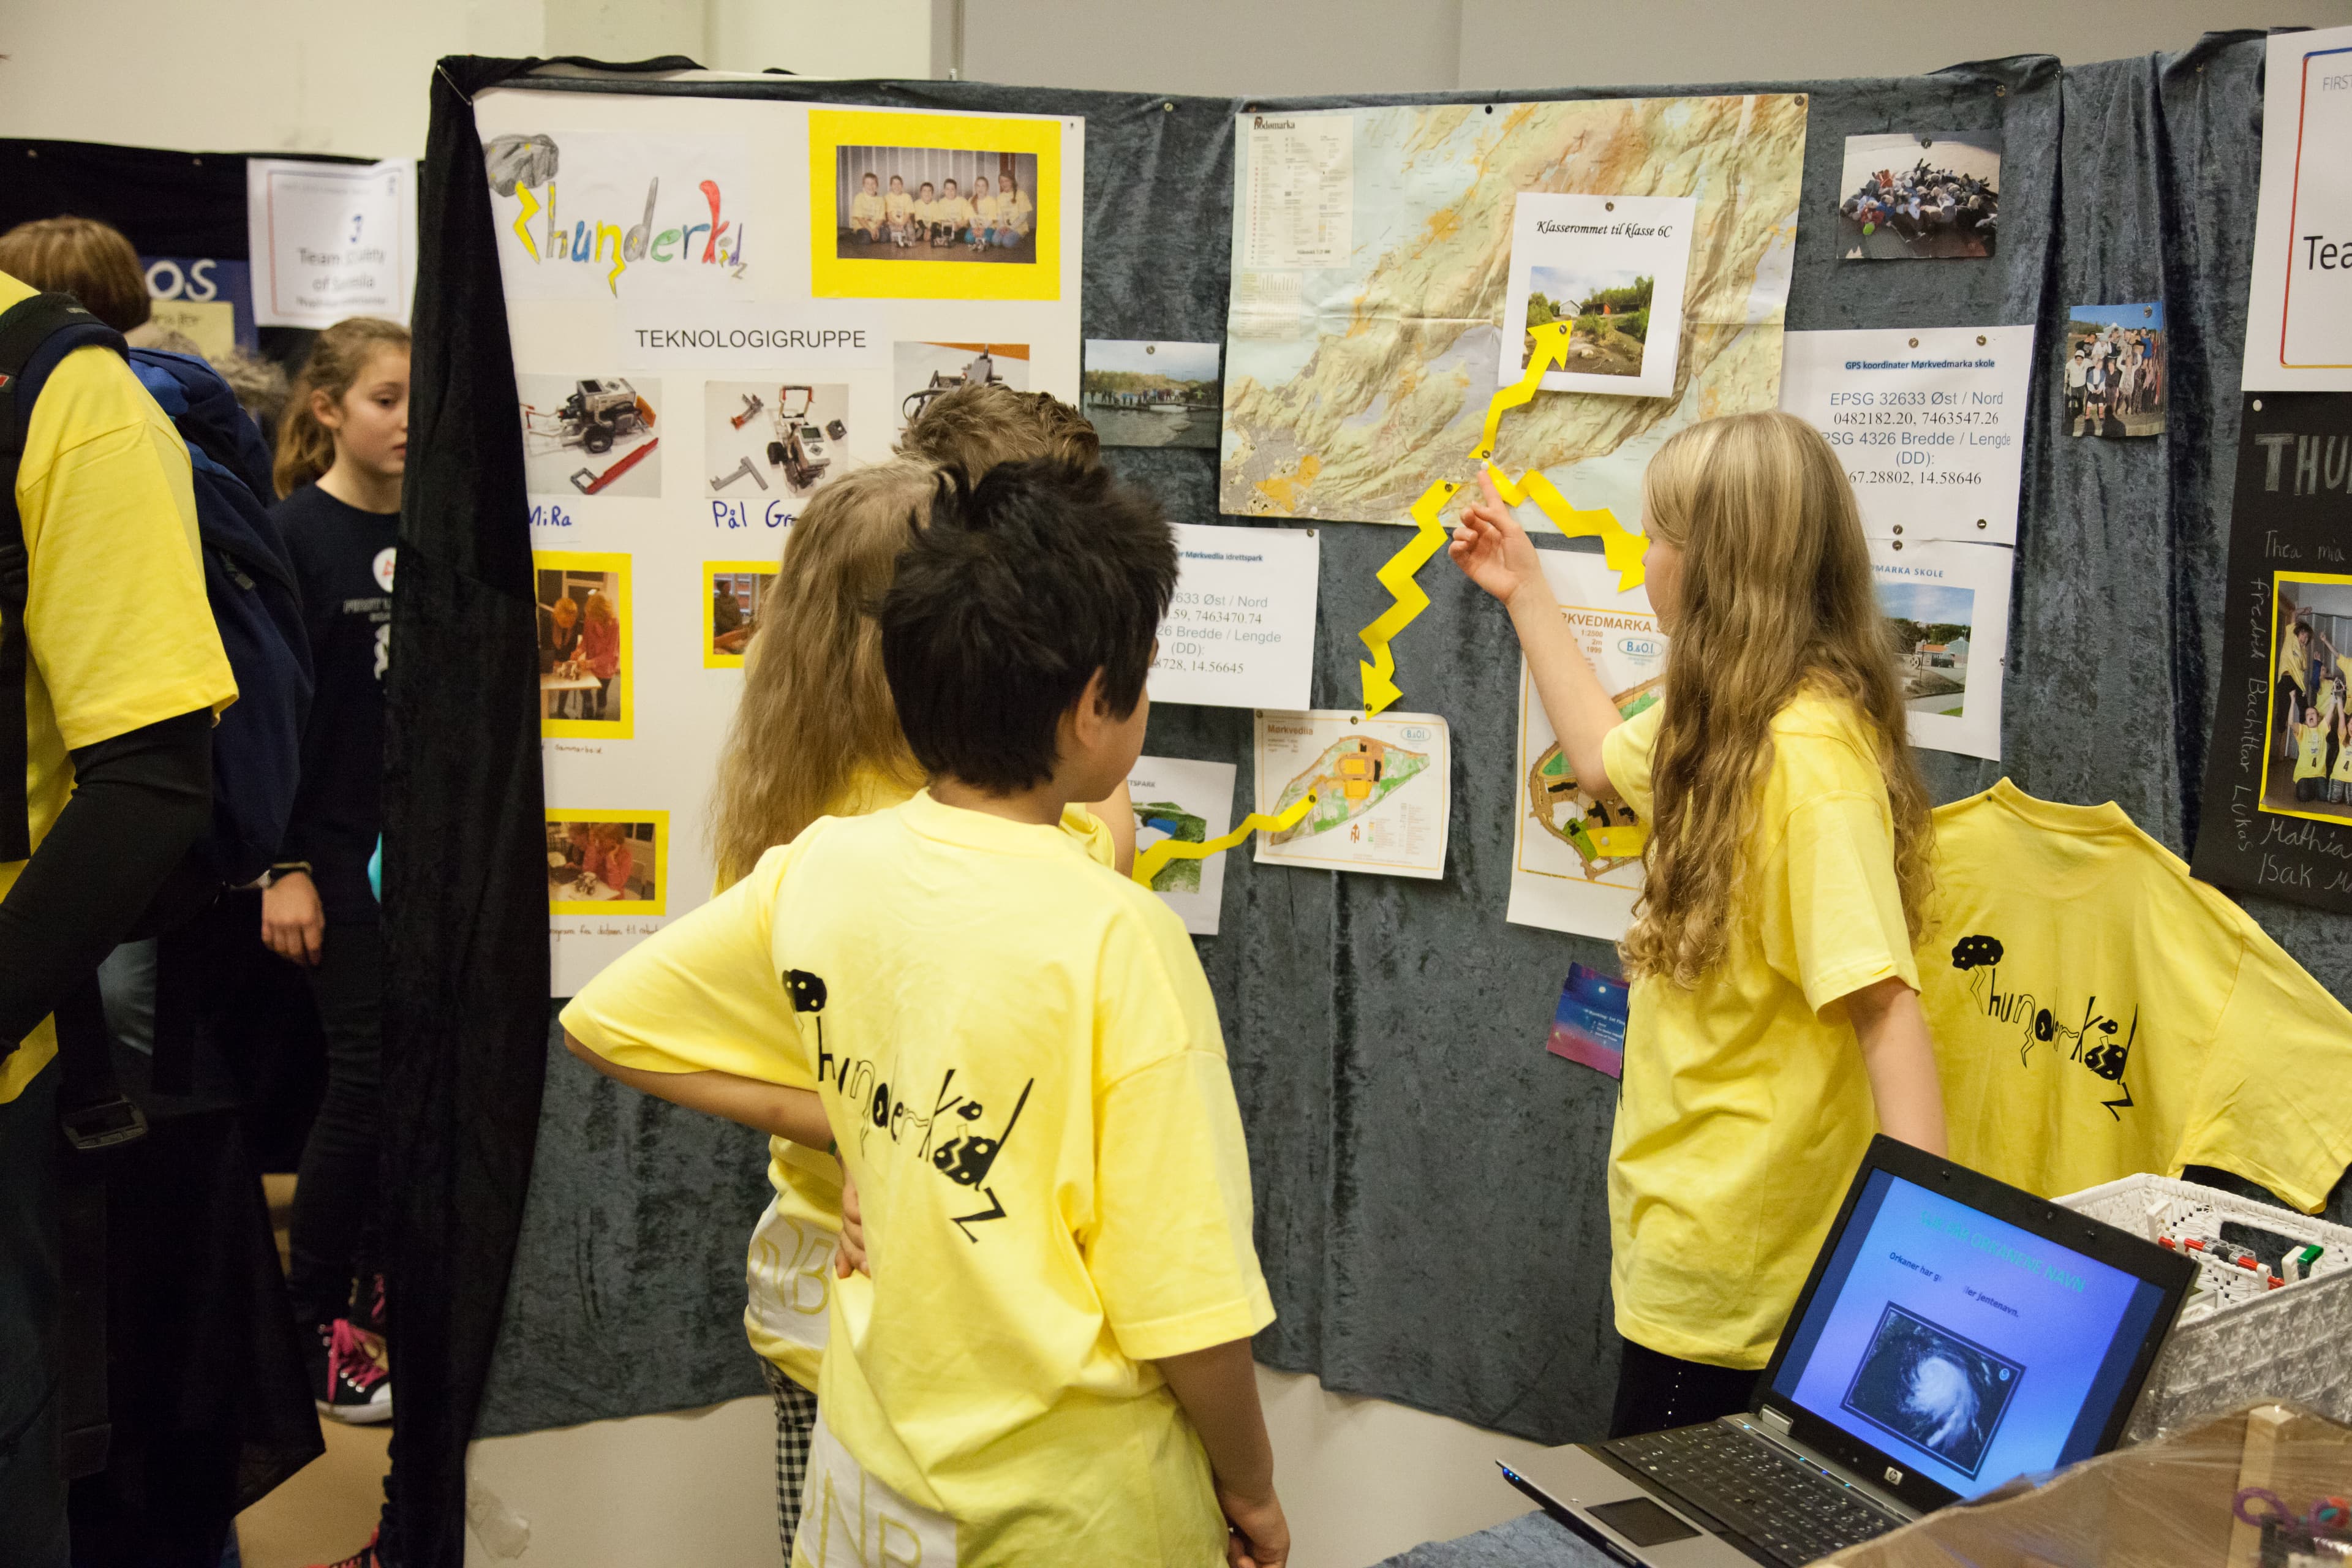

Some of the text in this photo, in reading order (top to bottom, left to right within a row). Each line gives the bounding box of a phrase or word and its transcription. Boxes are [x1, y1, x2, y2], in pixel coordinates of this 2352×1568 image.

[1537, 220, 1672, 238] Klasserommet til klasse 6C
[635, 329, 867, 349] TEKNOLOGIGRUPPE
[1845, 358, 1995, 370] GPS koordinater Mørkvedmarka skole
[1830, 391, 2003, 406] EPSG 32633 Øst / Nord
[1834, 411, 1999, 427] 0482182.20, 7463547.26
[1822, 432, 2011, 448] PSG 4326 Bredde / Lengde
[1896, 451, 1936, 467] (DD):
[1849, 471, 1982, 485] 67.28802, 14.58646
[712, 500, 747, 529] Pål
[2265, 530, 2301, 559] Thea
[1186, 551, 1224, 560] Mørkvedlia
[1226, 552, 1264, 562] idrettspark
[1913, 568, 1943, 578] SKOLE
[1174, 592, 1199, 605] 633
[1204, 594, 1225, 606] Øst
[1237, 596, 1268, 608] Nord
[1196, 611, 1262, 624] 7463470.74
[1156, 625, 1172, 636] 26
[1177, 626, 1223, 639] Bredde
[1234, 629, 1281, 644] Lengde
[1171, 642, 1205, 657] (DD):
[1154, 658, 1244, 674] 8728, 14.56645
[2260, 818, 2352, 858] Mathia
[1890, 1252, 1933, 1278] Orkaner har
[2045, 1264, 2086, 1293] NAVN
[1976, 1292, 2019, 1317] jentenavn.
